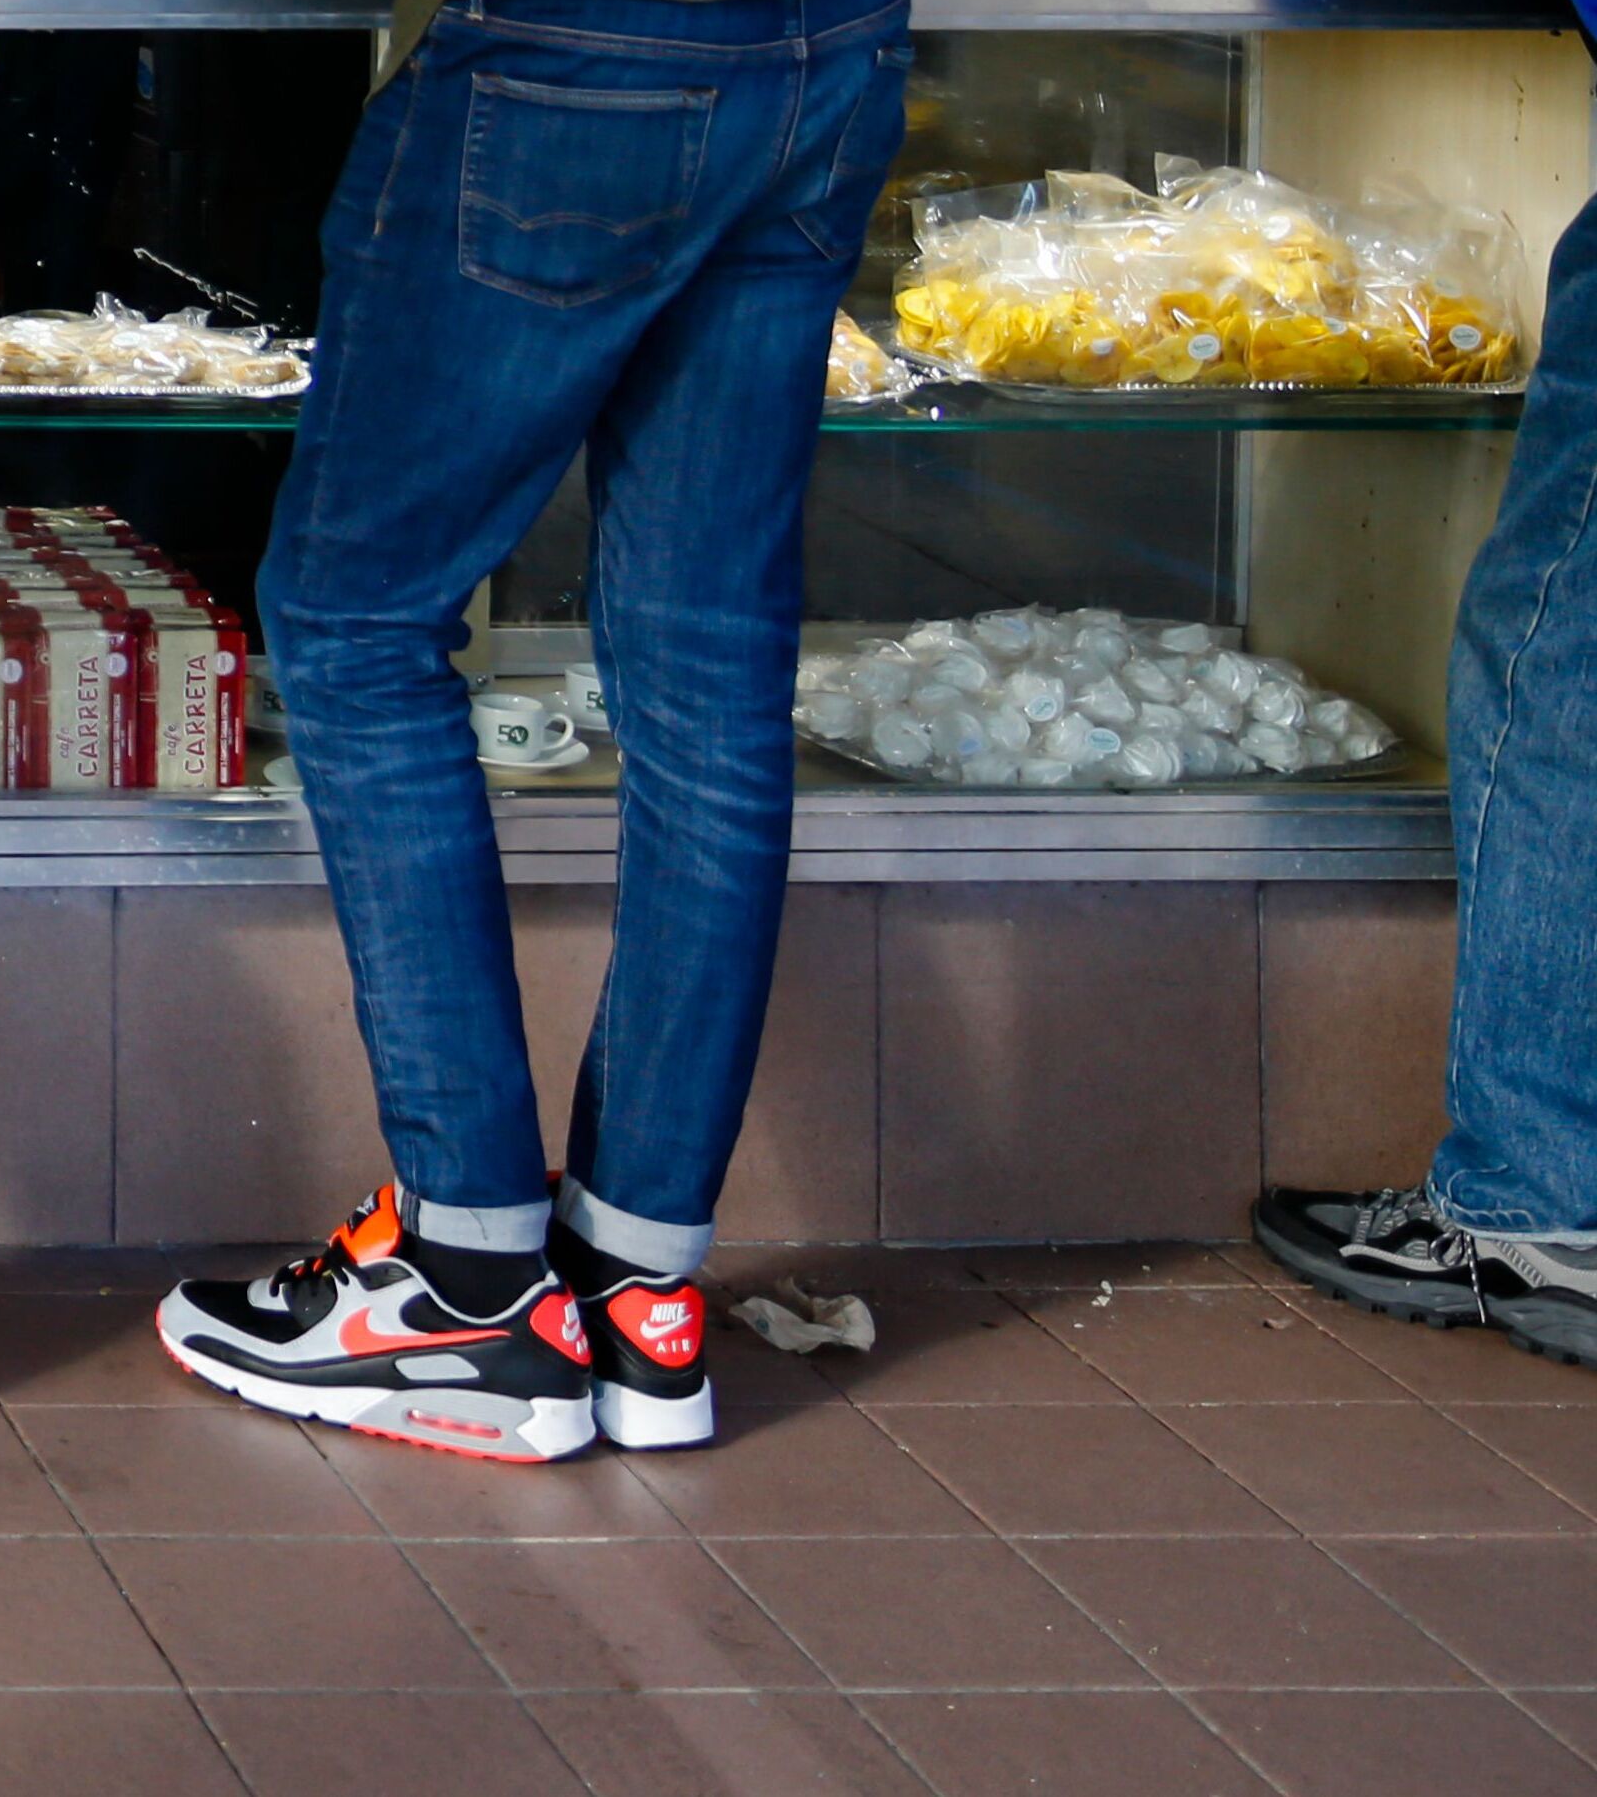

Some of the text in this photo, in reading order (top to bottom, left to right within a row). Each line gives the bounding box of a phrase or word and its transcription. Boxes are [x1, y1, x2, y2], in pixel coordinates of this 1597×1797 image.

[77, 655, 100, 778] CARRETA
[184, 654, 208, 775] CARRETA
[649, 1302, 688, 1323] NIKE
[655, 1338, 692, 1354] AIR
